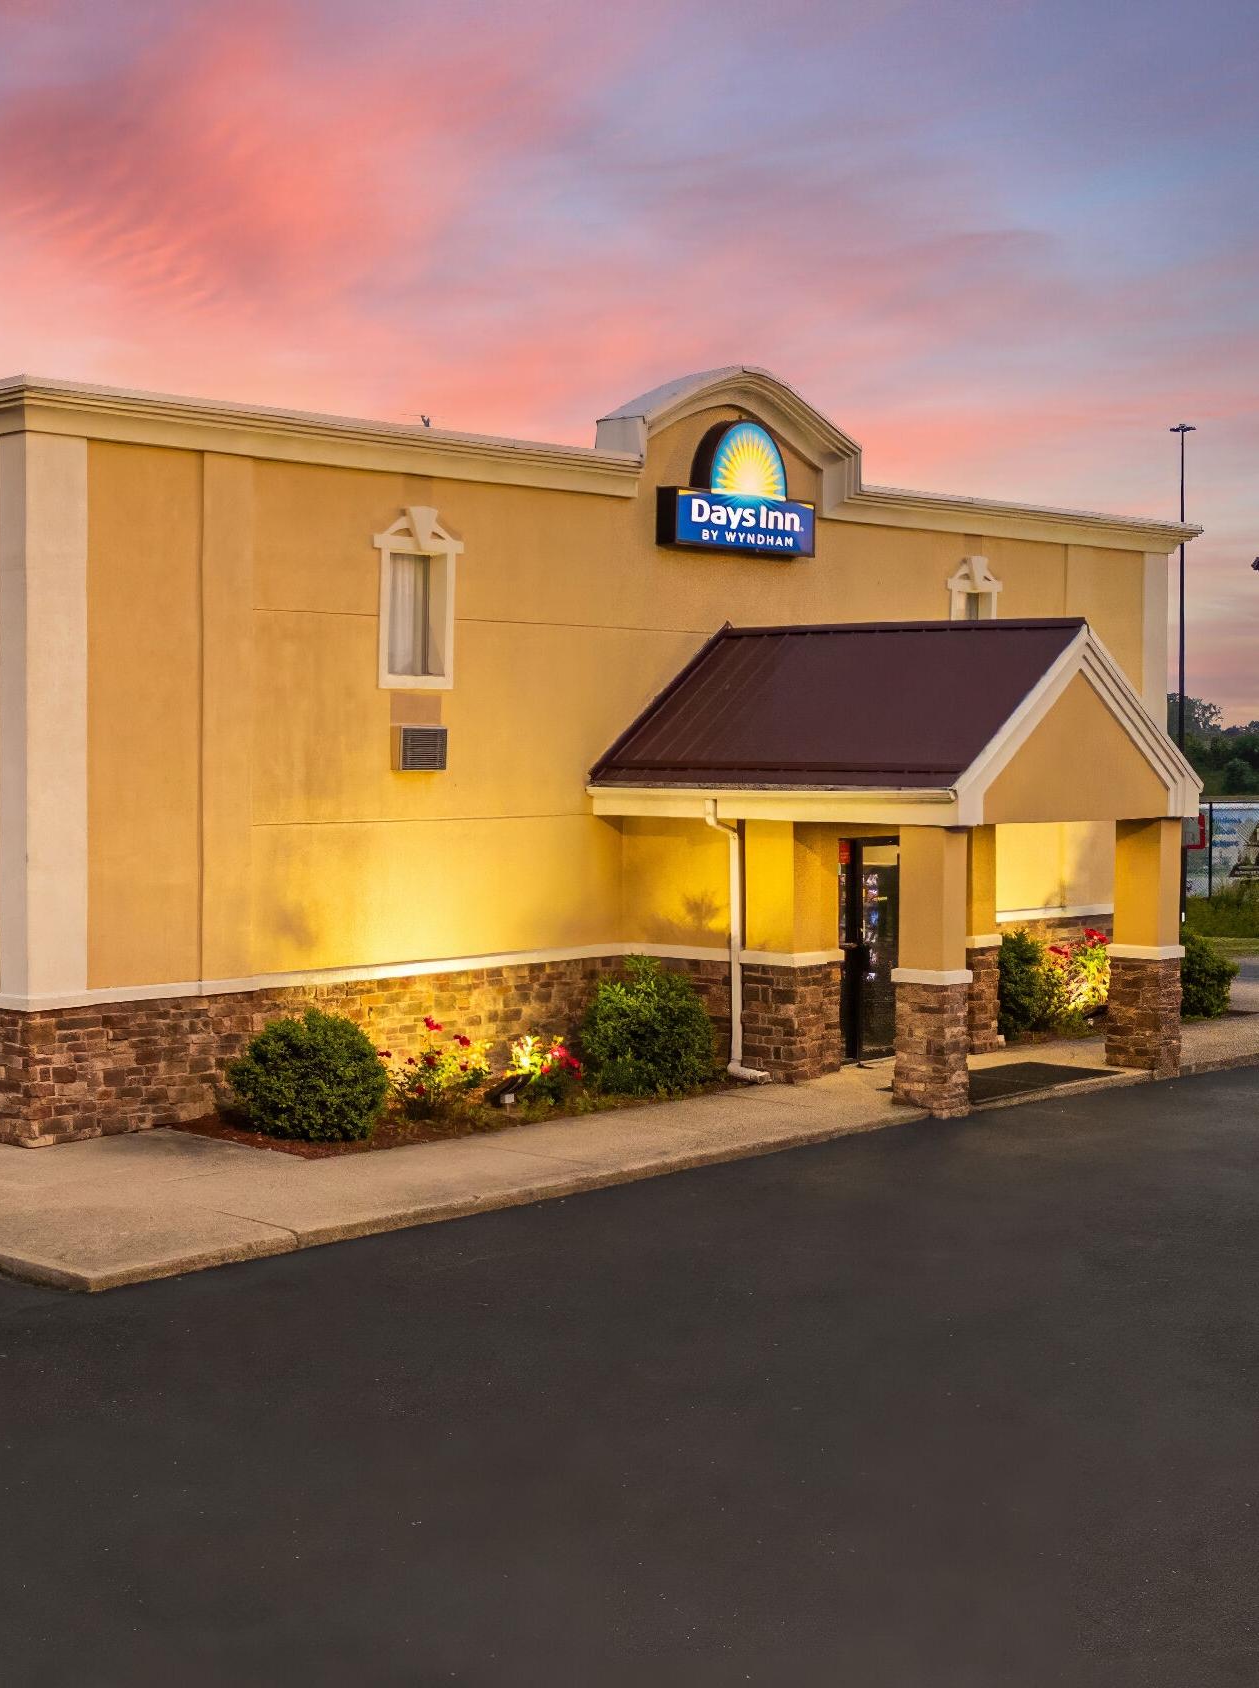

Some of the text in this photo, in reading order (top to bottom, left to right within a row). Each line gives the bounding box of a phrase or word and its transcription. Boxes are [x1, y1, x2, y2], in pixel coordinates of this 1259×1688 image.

[691, 498, 801, 532] Days Inn
[701, 528, 794, 547] BY WYNDHAM
